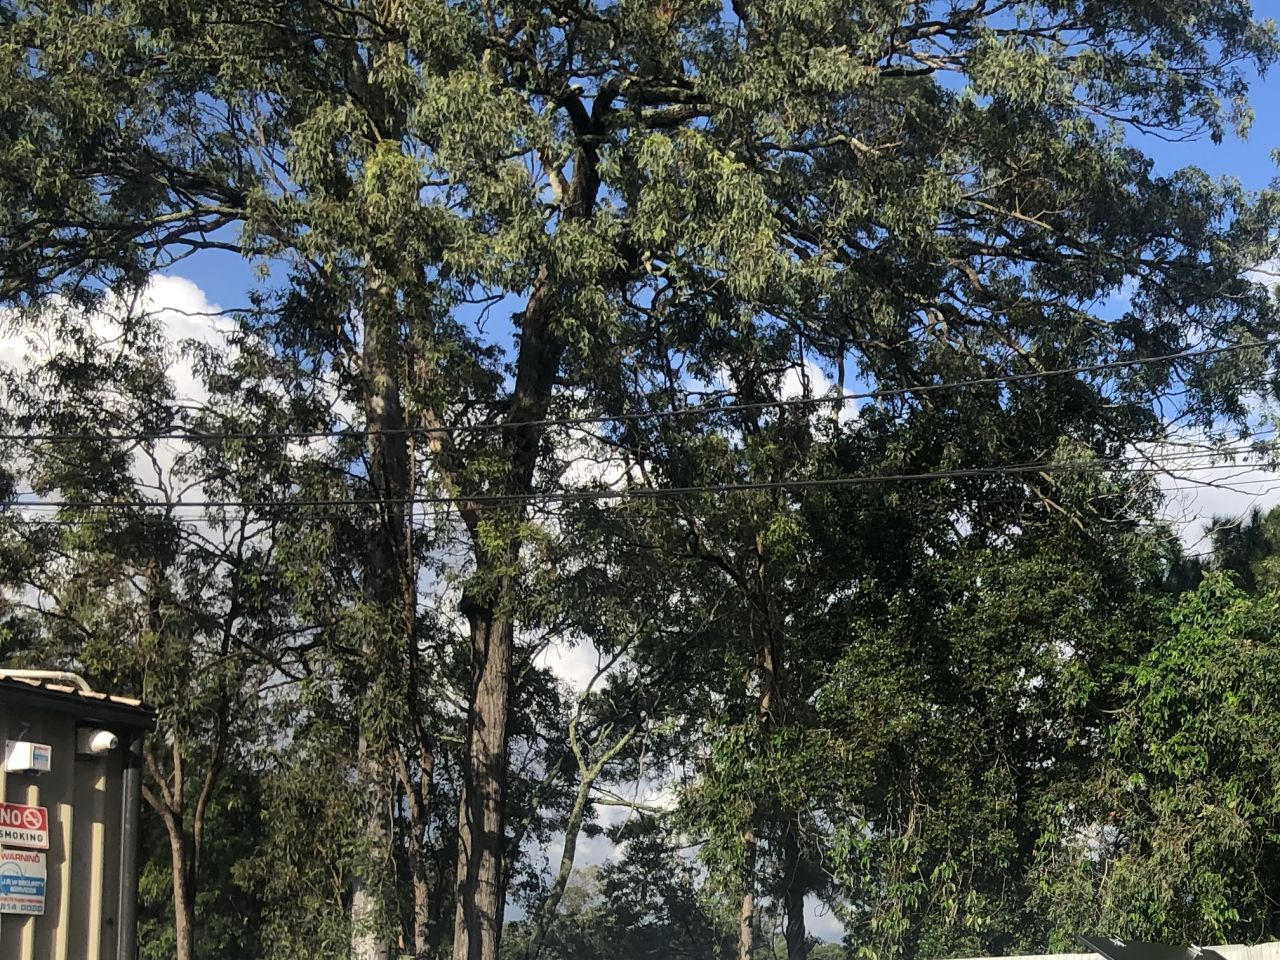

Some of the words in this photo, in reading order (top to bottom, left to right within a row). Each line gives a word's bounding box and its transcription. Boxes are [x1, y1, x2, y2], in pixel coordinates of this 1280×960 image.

[0, 807, 21, 825] NO
[0, 829, 43, 842] SMOKING
[1, 852, 40, 863] WARNING
